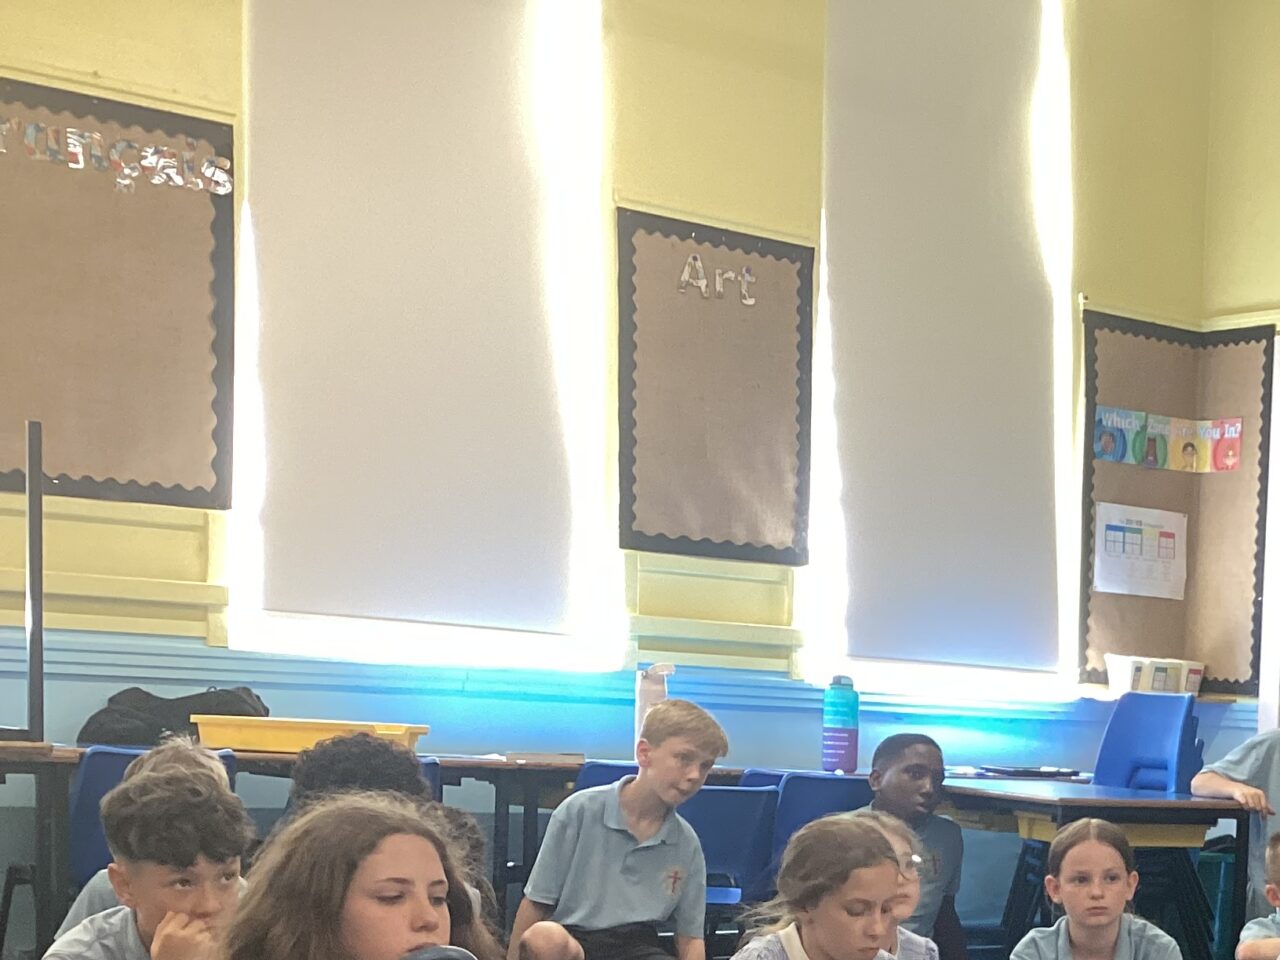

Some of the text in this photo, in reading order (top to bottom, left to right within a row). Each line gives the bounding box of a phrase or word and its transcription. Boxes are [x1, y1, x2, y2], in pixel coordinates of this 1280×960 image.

[678, 253, 757, 306] Art
[1101, 411, 1141, 431] Which
[1199, 426, 1221, 440] You
[1224, 423, 1242, 439] In?
